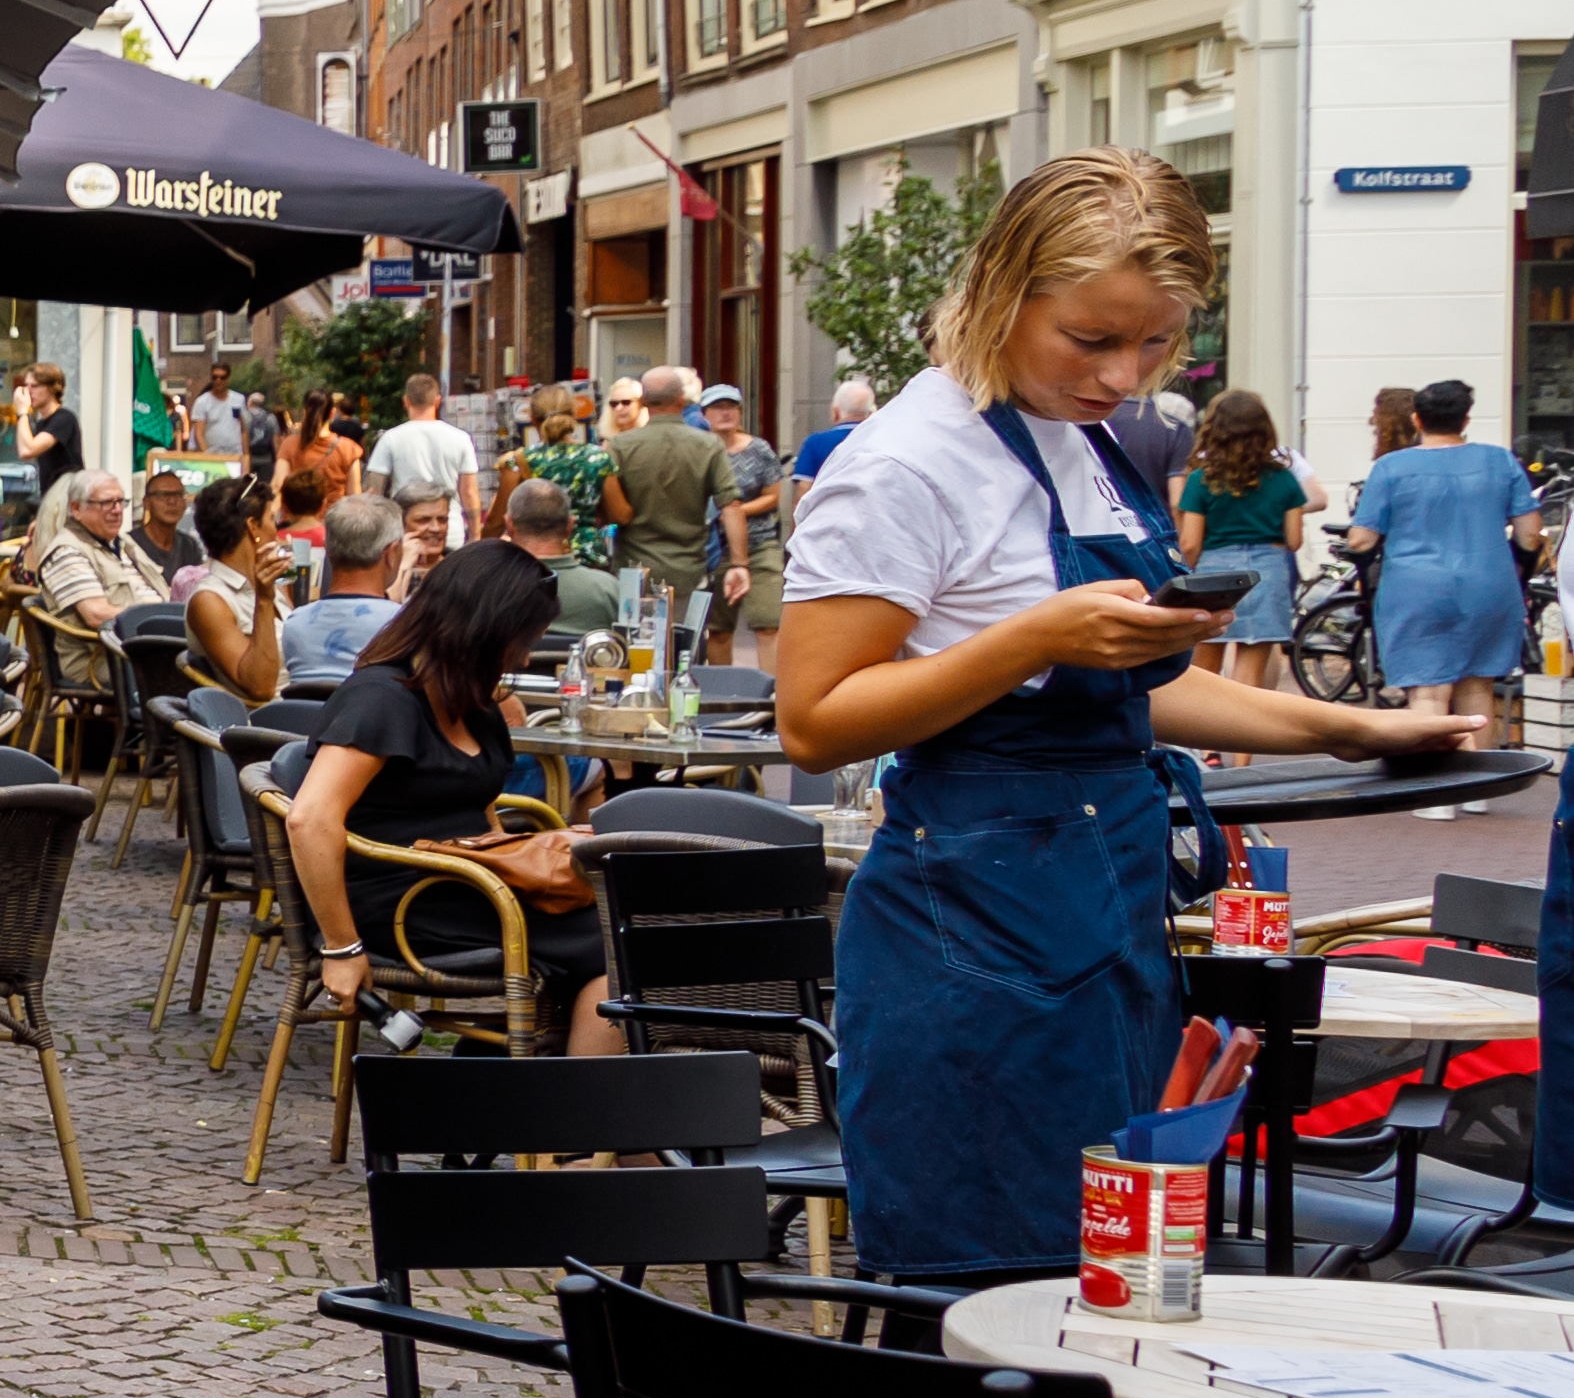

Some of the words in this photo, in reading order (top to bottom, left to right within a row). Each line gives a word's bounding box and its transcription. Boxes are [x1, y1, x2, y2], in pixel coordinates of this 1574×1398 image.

[1352, 171, 1455, 187] Kolfstraat
[125, 167, 283, 221] Warsteiner
[1263, 900, 1290, 912] MUT
